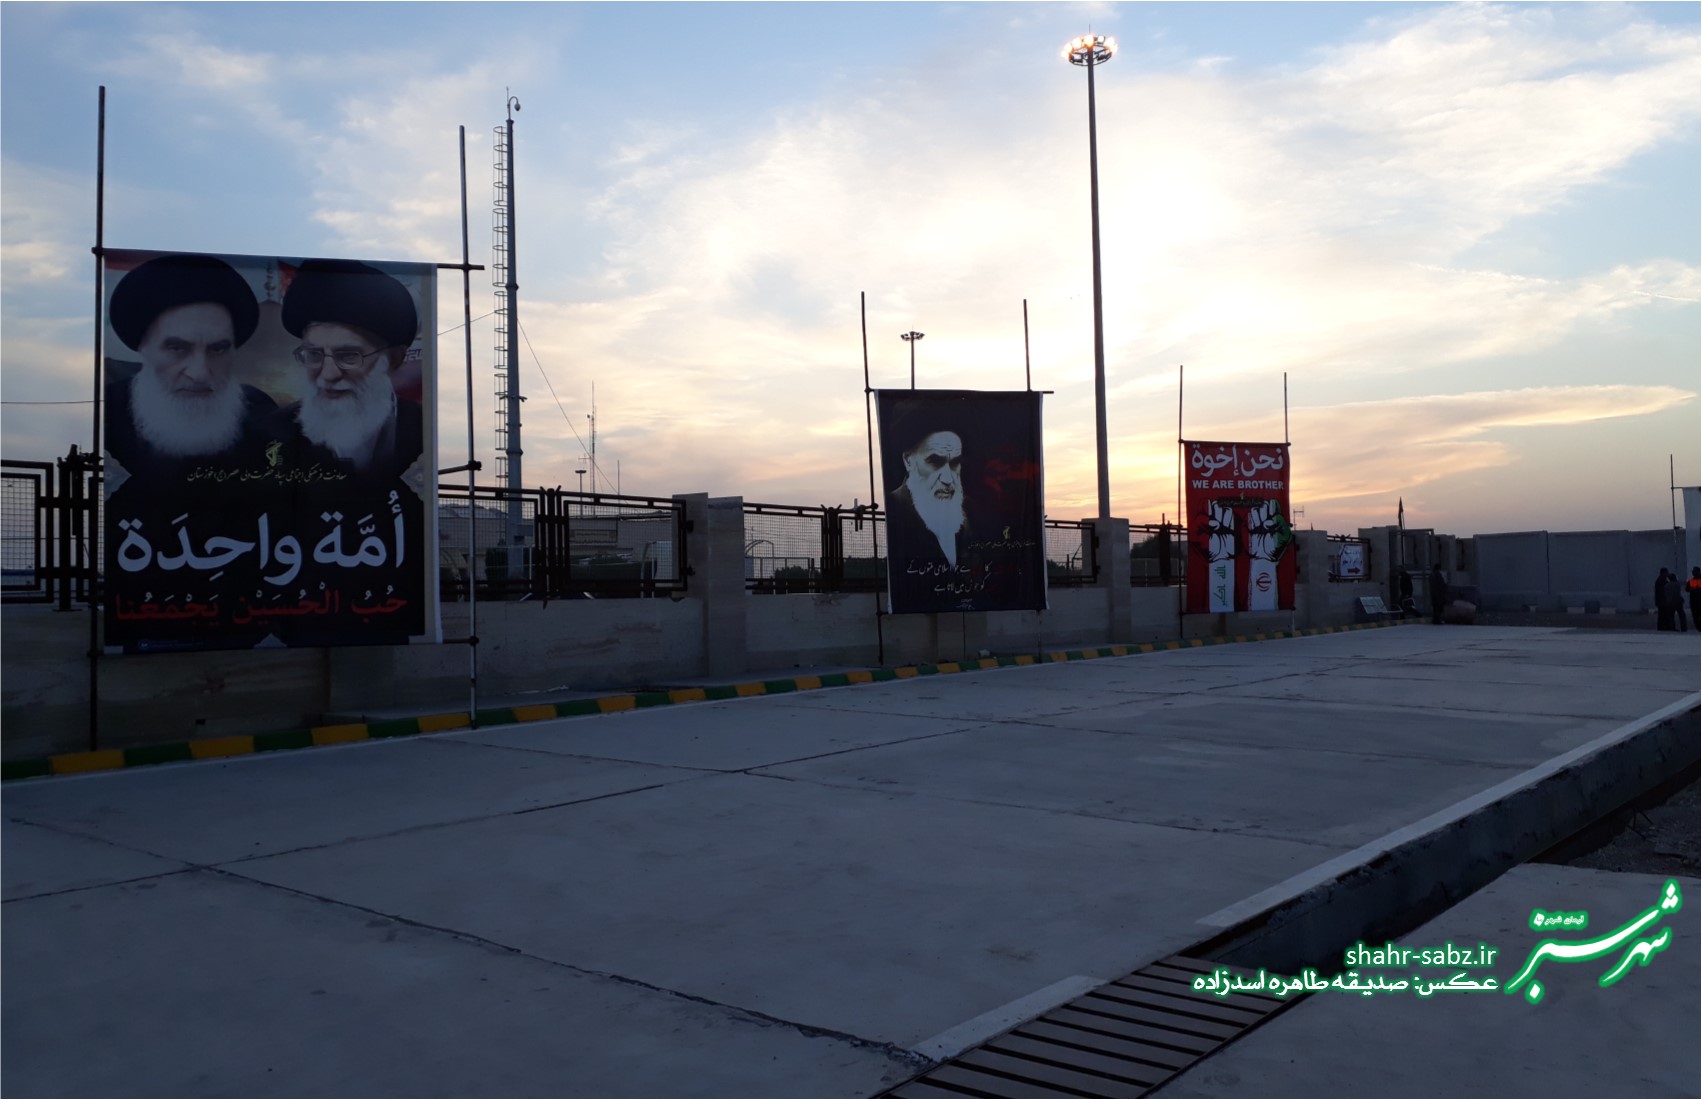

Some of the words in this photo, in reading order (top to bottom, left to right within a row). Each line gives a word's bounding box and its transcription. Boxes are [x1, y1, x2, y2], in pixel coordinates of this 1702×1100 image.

[1241, 447, 1284, 477] نحن
[1192, 480, 1209, 489] WE
[1212, 480, 1234, 489] ARE
